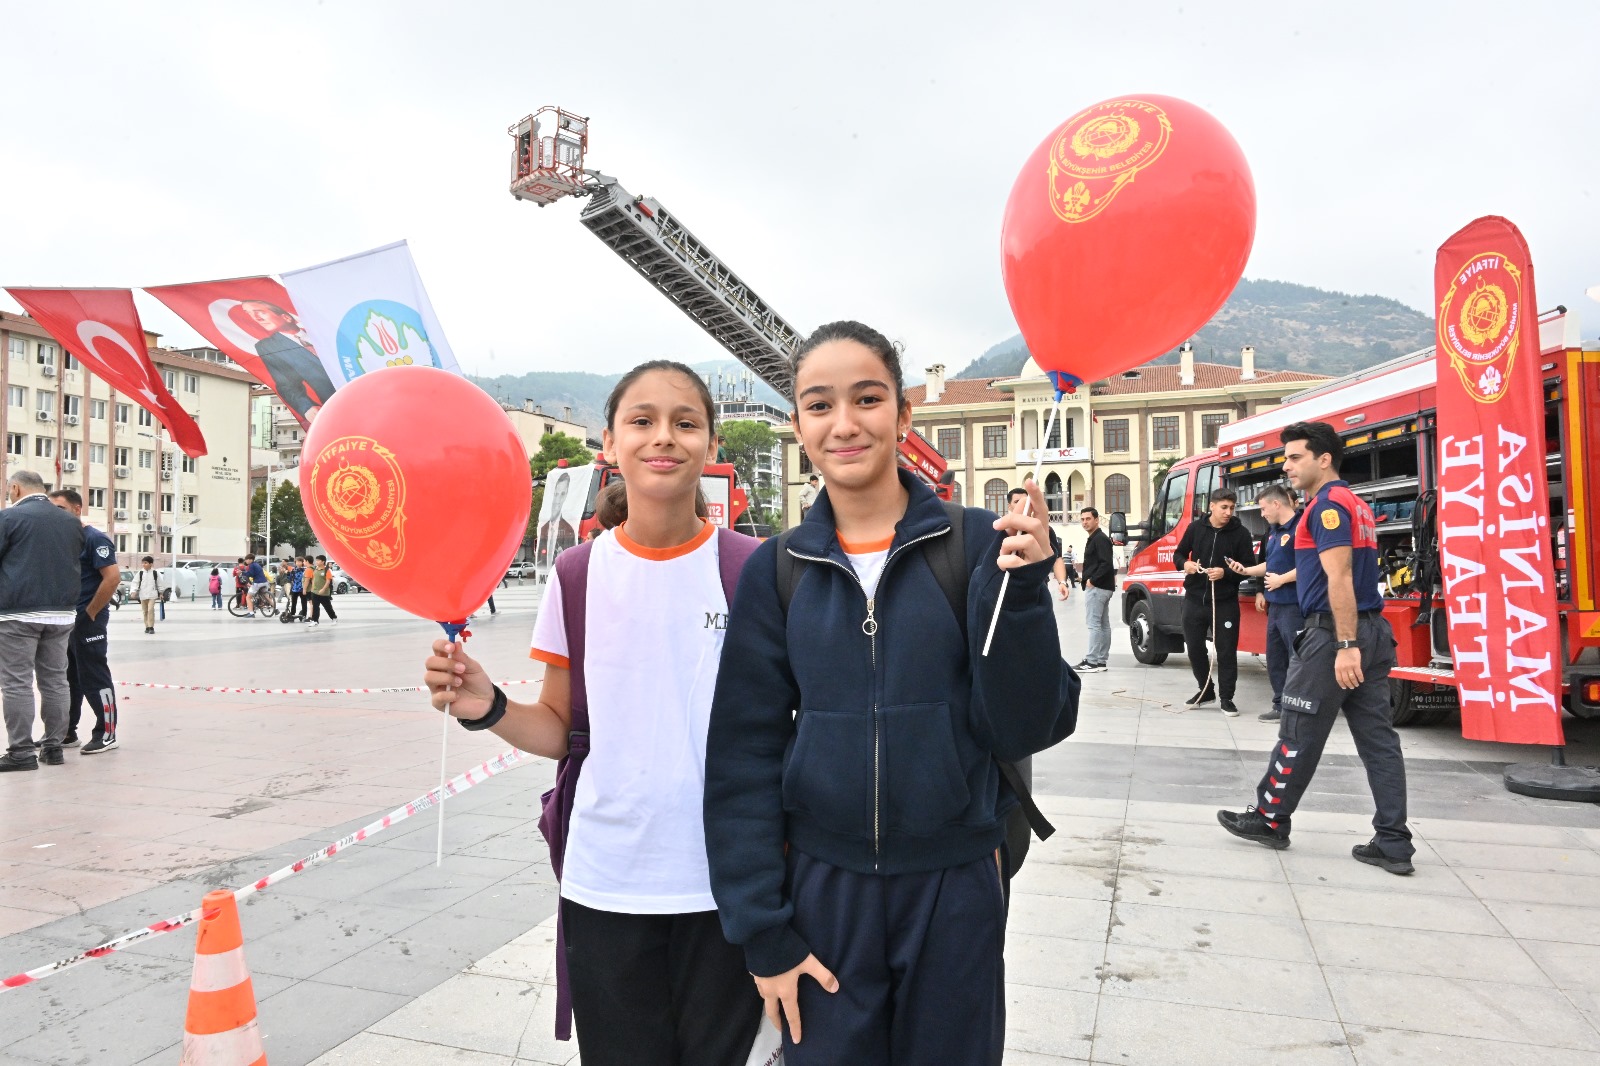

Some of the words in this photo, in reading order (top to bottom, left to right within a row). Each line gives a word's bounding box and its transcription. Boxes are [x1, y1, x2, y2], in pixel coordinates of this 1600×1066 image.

[1109, 141, 1154, 172] BELEDİYESİ
[321, 440, 368, 464] İTFAİYE
[321, 503, 340, 527] MANİSA
[340, 520, 383, 535] BÜYÜKŞEHİR
[380, 479, 396, 522] BELEDİYESİ
[1282, 692, 1312, 710] İTFAİYE
